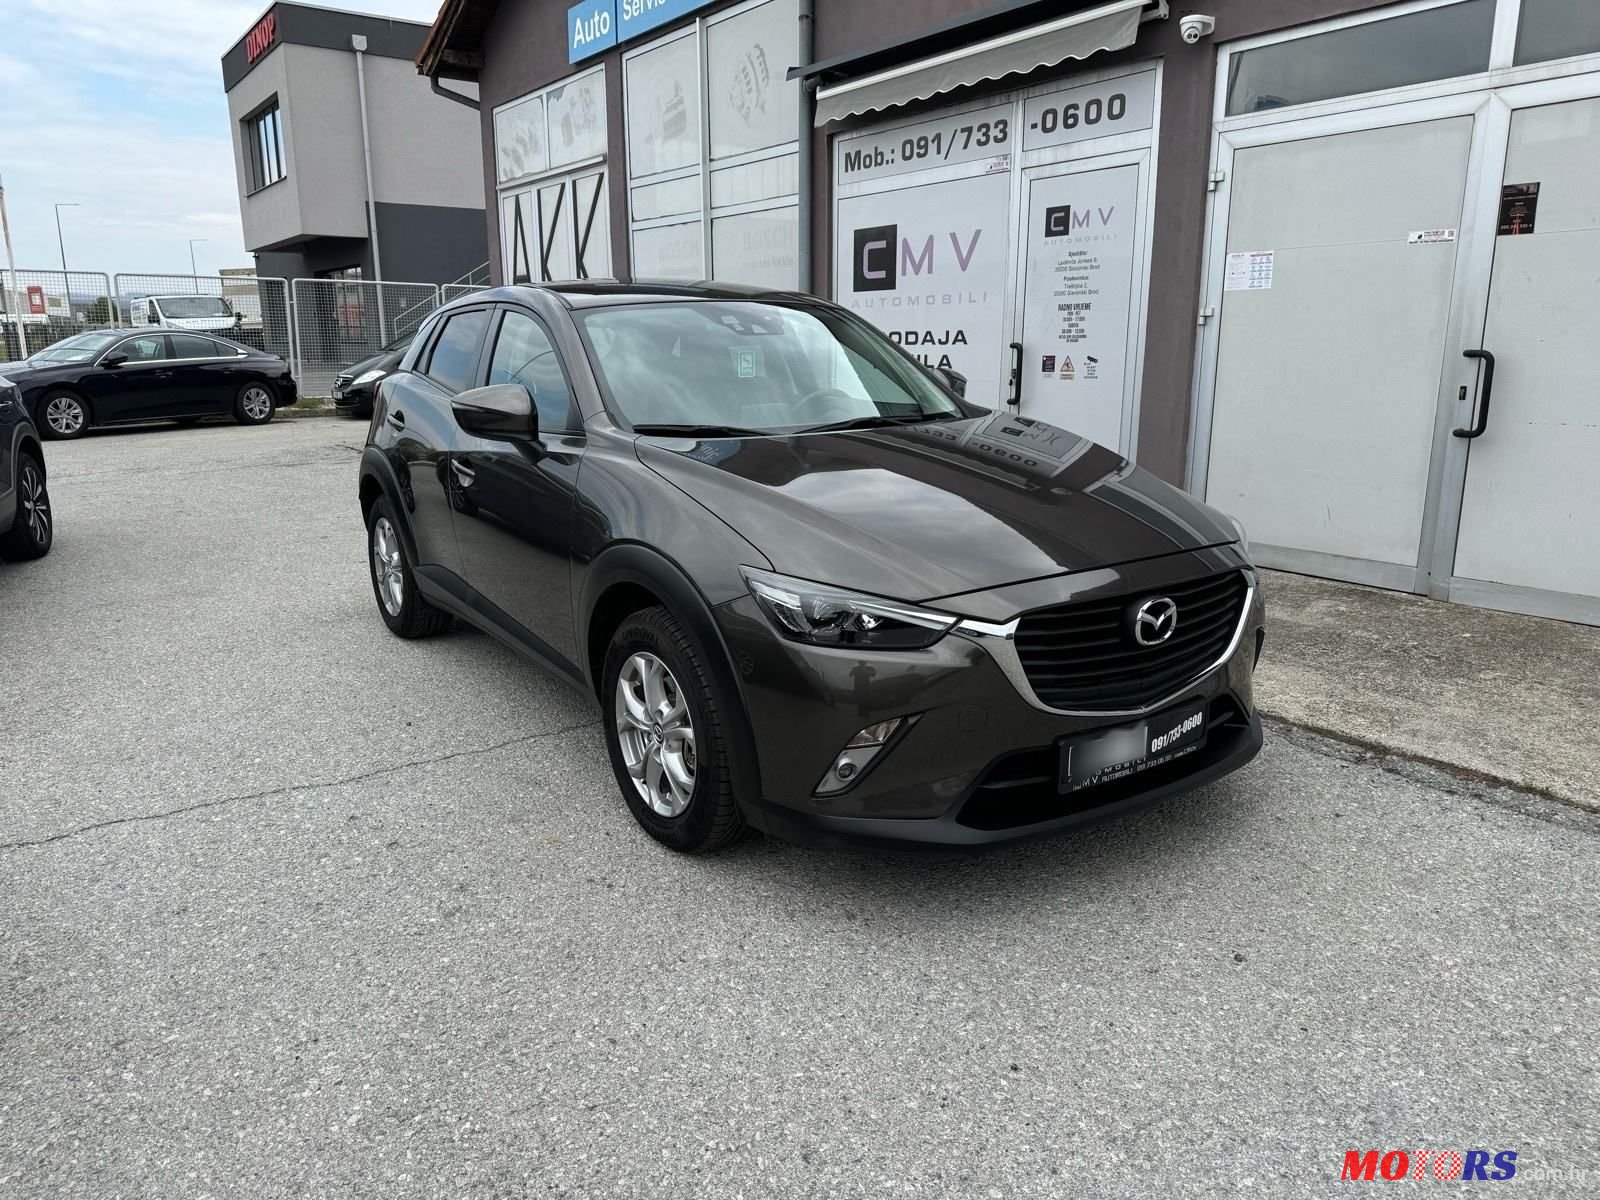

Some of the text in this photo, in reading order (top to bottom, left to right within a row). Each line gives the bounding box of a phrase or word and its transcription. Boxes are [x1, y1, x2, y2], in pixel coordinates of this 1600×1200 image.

[573, 10, 611, 48] Auto
[844, 147, 895, 174] Mob.:
[901, 119, 1009, 160] 091/733
[1049, 206, 1115, 231] CMV
[861, 229, 982, 279] CMV
[1043, 233, 1117, 246] AUTOMOBILI
[851, 292, 987, 309] AUTOMOBILI
[887, 329, 968, 346] ODAJA
[1151, 711, 1203, 752] 091/733-0600
